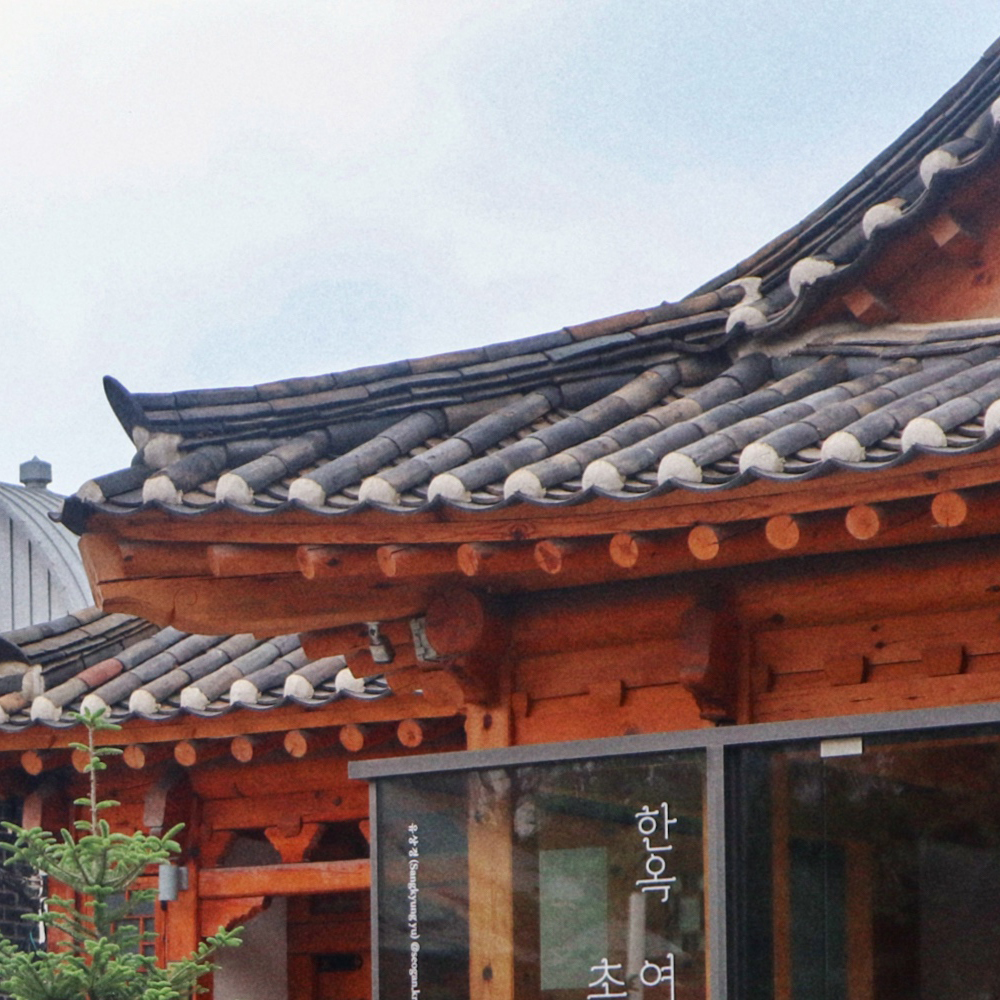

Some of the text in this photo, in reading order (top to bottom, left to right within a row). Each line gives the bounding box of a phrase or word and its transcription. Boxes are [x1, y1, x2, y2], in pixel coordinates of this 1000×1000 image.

[635, 802, 677, 902] 한옥
[408, 860, 419, 921] (Sangkyung
[408, 923, 419, 939] yu)
